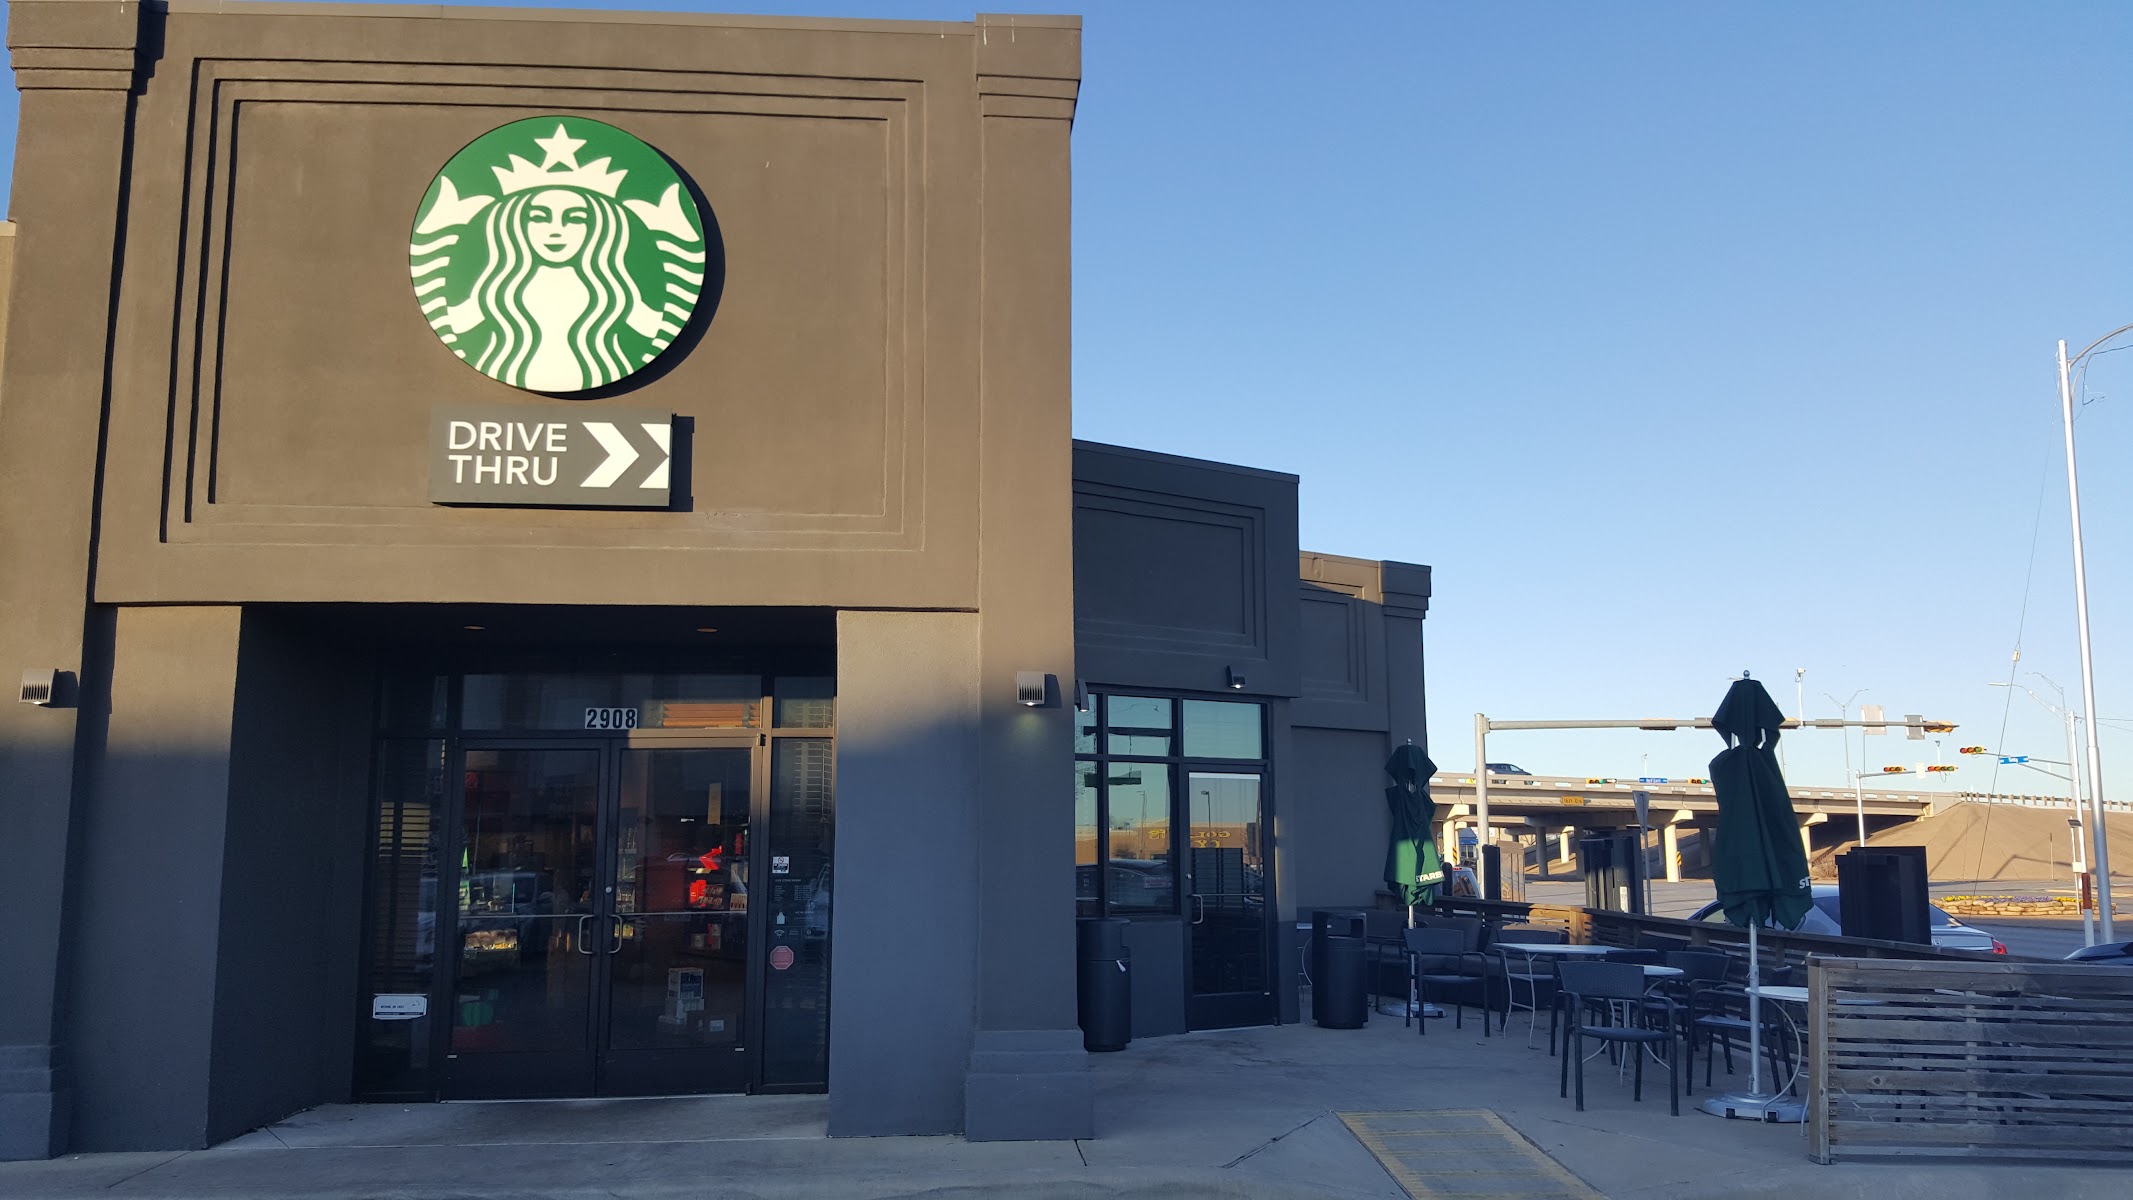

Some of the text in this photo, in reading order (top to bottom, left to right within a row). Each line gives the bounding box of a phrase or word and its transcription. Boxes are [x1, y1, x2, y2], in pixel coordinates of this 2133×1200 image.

[449, 421, 567, 452] DRIVE
[448, 455, 558, 486] THRU
[586, 708, 636, 729] 2908
